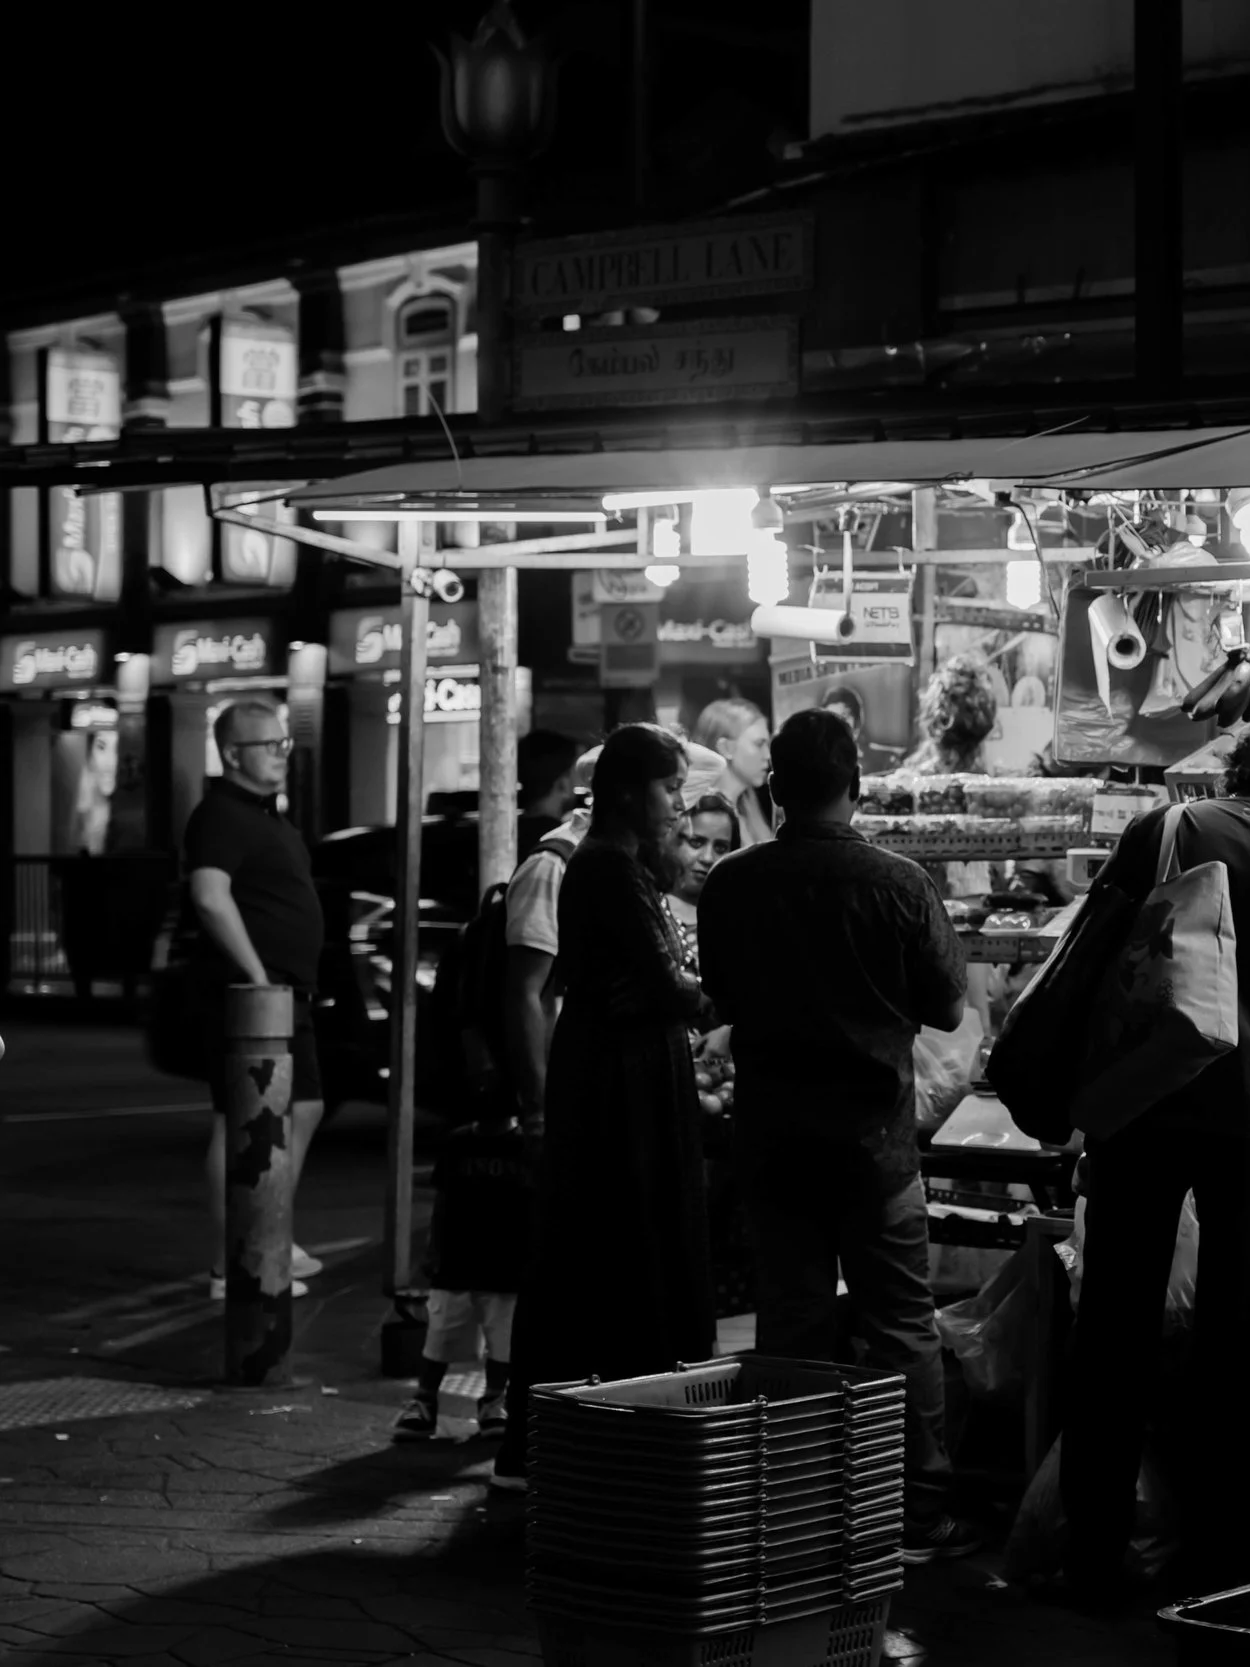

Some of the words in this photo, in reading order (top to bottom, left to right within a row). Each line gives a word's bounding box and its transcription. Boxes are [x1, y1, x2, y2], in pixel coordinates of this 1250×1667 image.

[531, 244, 690, 296] CAMPBELL
[705, 231, 792, 279] LANE
[863, 606, 900, 620] NETS
